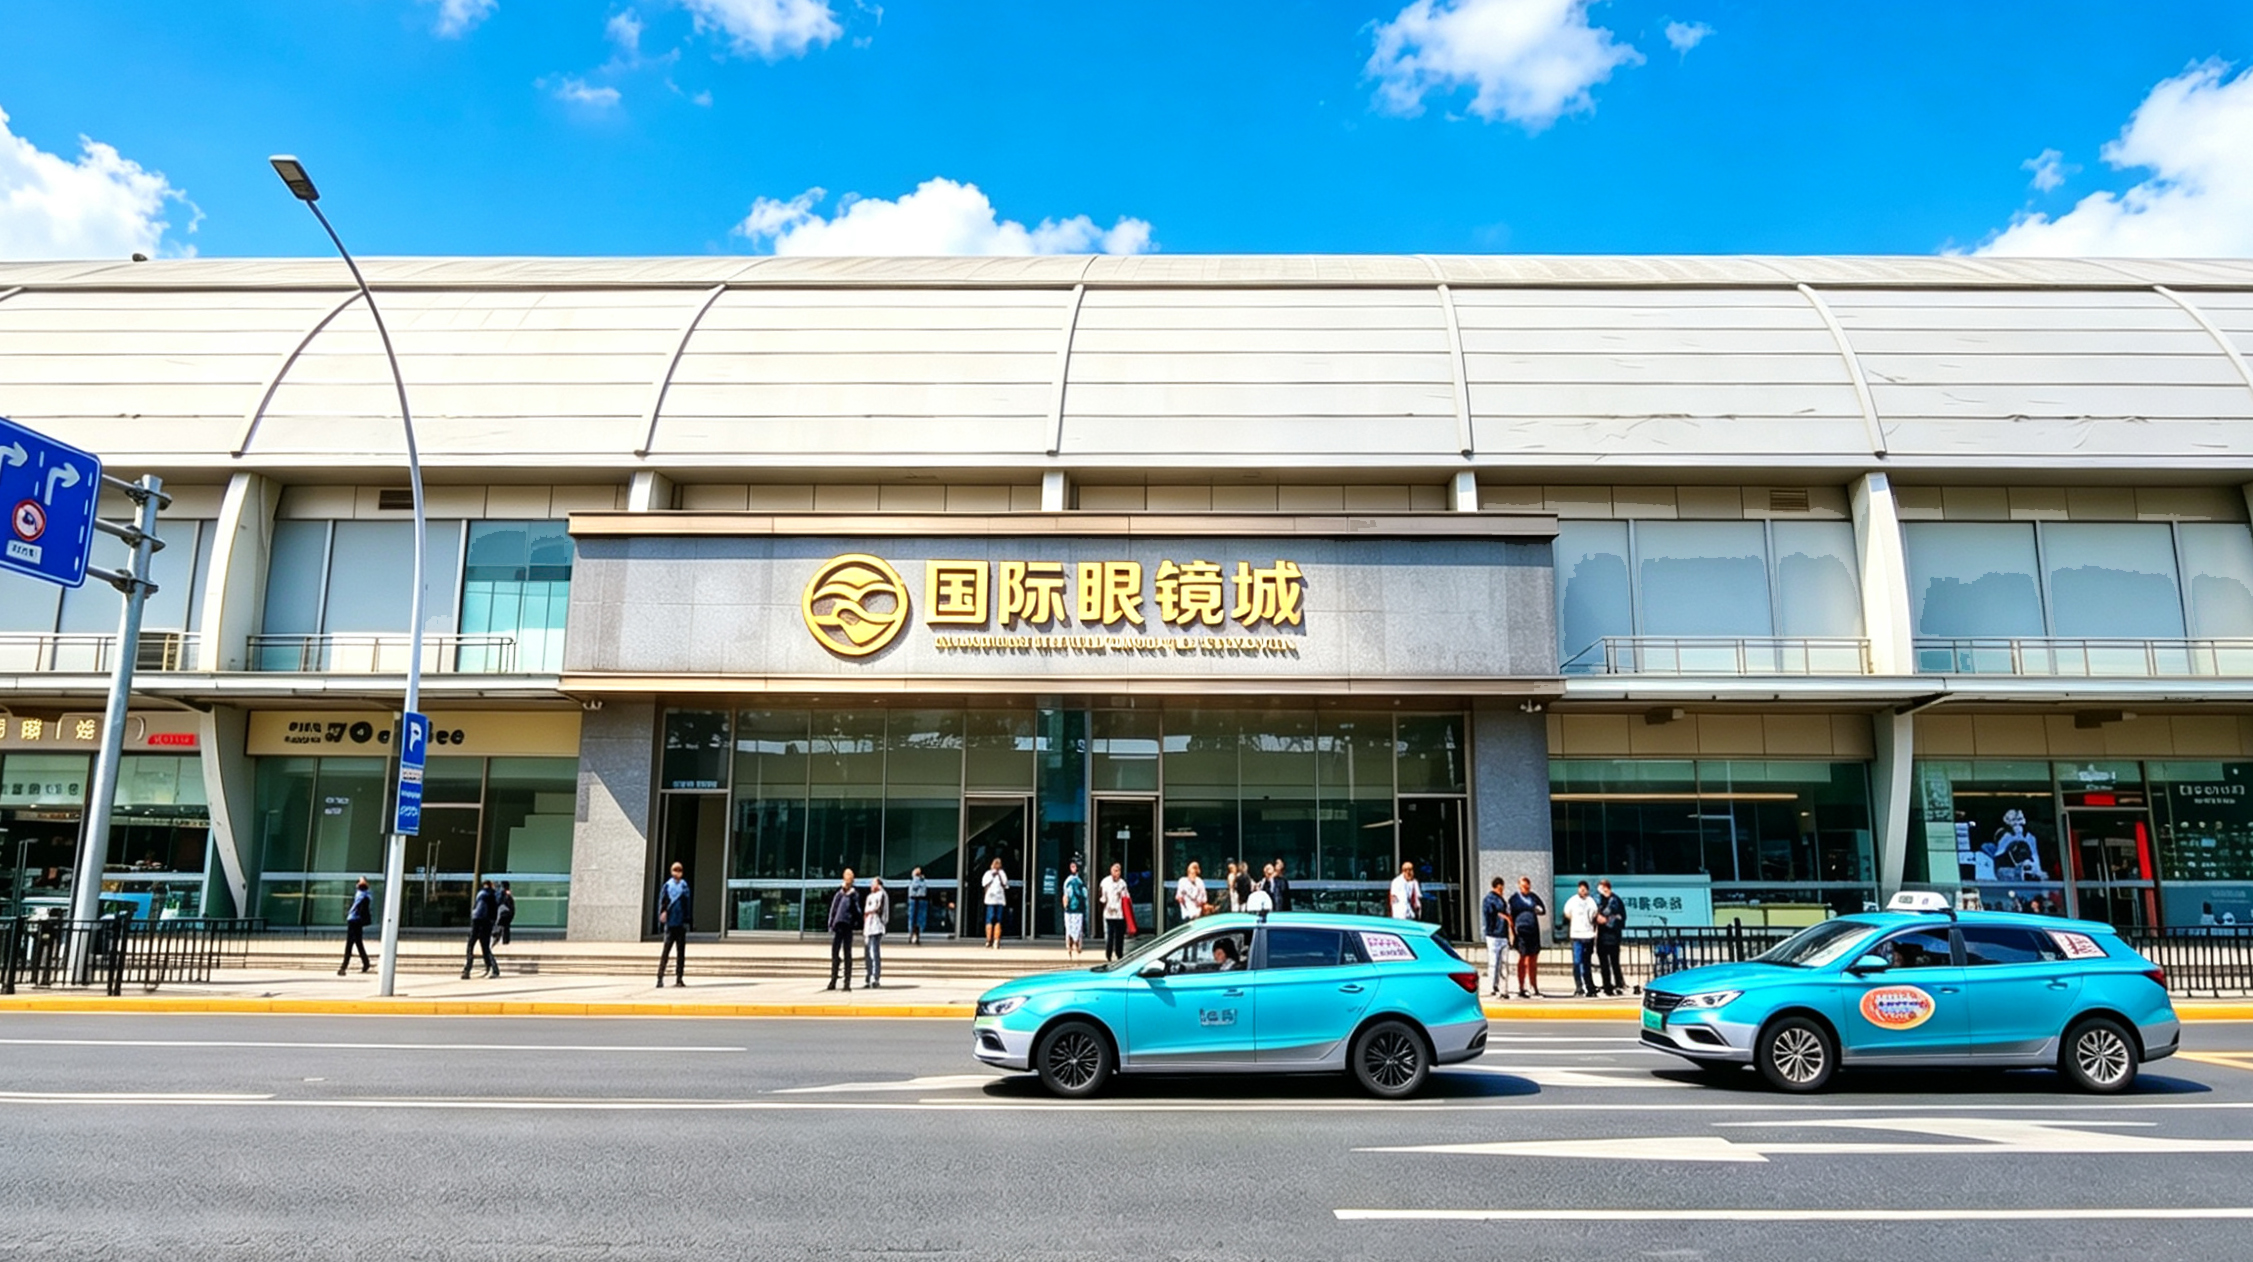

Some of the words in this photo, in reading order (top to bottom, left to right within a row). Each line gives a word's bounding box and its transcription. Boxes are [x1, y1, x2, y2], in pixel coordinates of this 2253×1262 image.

[925, 559, 1304, 627] 国际眼镜城
